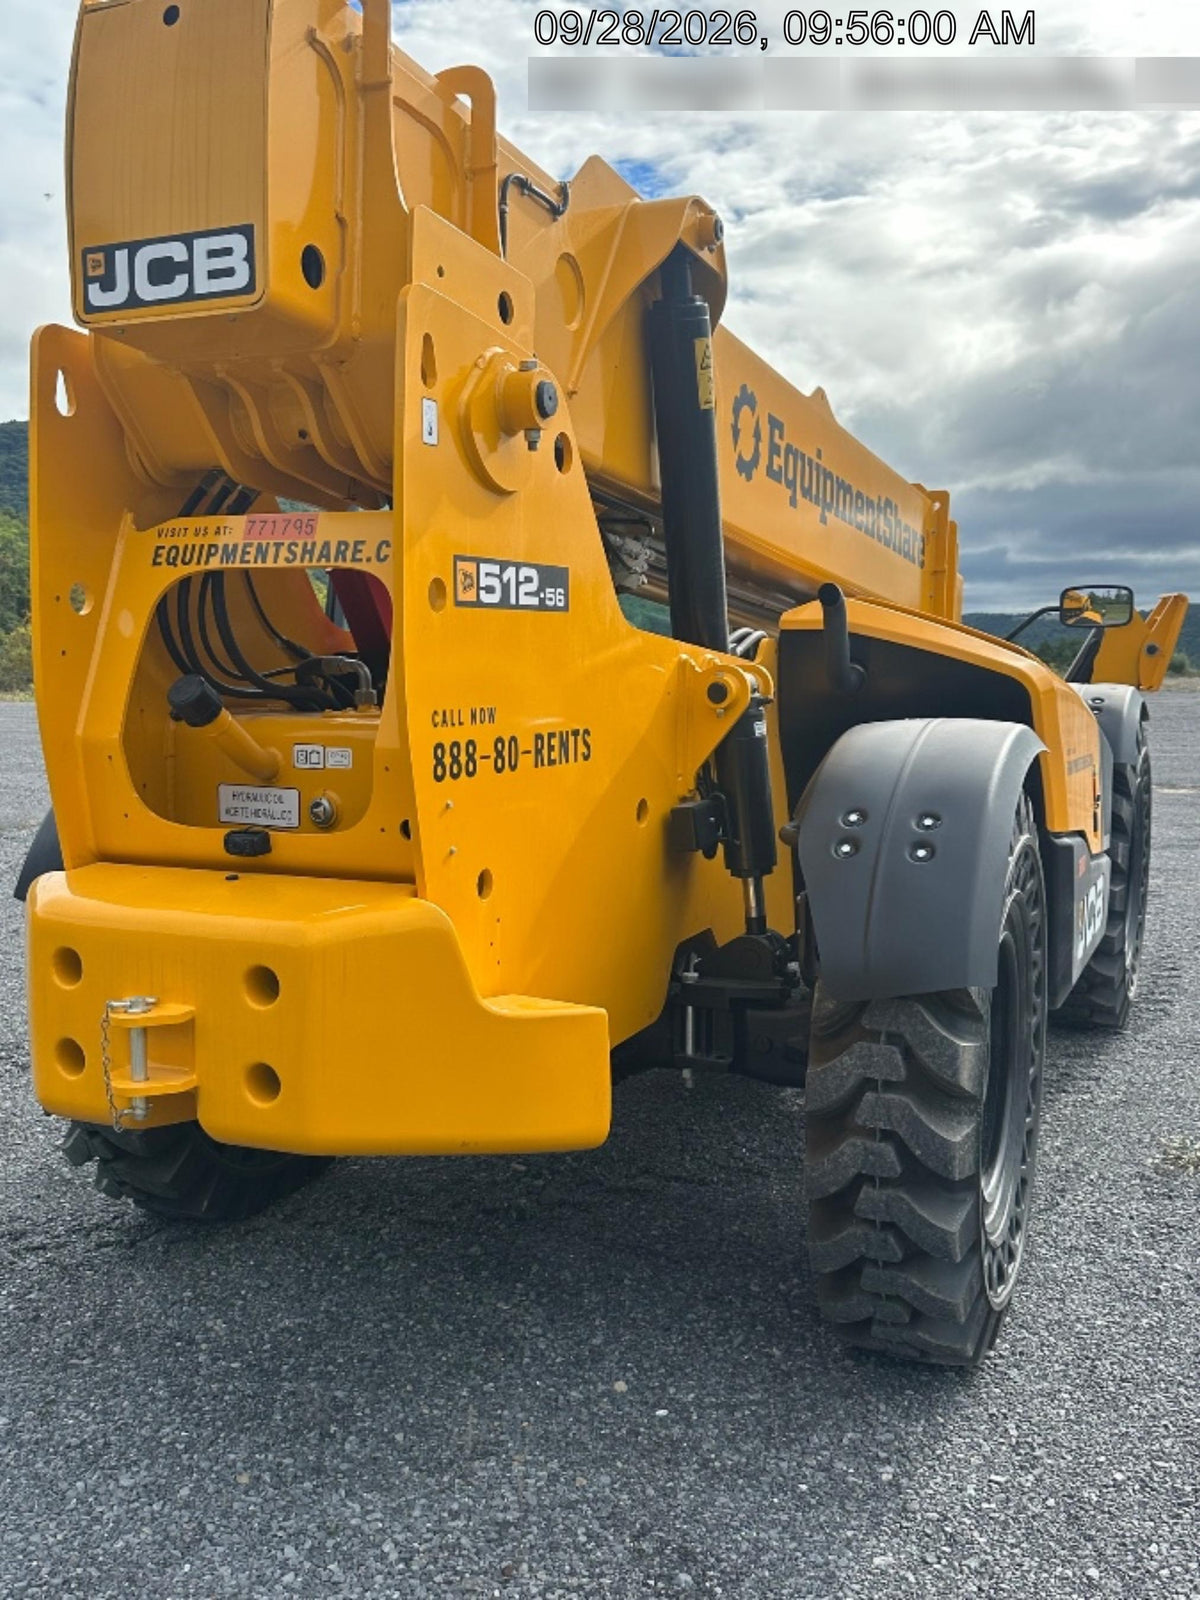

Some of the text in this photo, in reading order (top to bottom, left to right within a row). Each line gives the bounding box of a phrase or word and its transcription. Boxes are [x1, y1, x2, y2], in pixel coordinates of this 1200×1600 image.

[87, 233, 250, 307] JCB
[766, 412, 925, 569] EquipmentShare
[157, 525, 233, 539] VISIT US AT:
[247, 518, 317, 537] 771795
[152, 539, 392, 566] EQUIPMENTSHARE.C
[431, 706, 497, 728] CALL NOW
[433, 728, 592, 783] 888-80-RENTS
